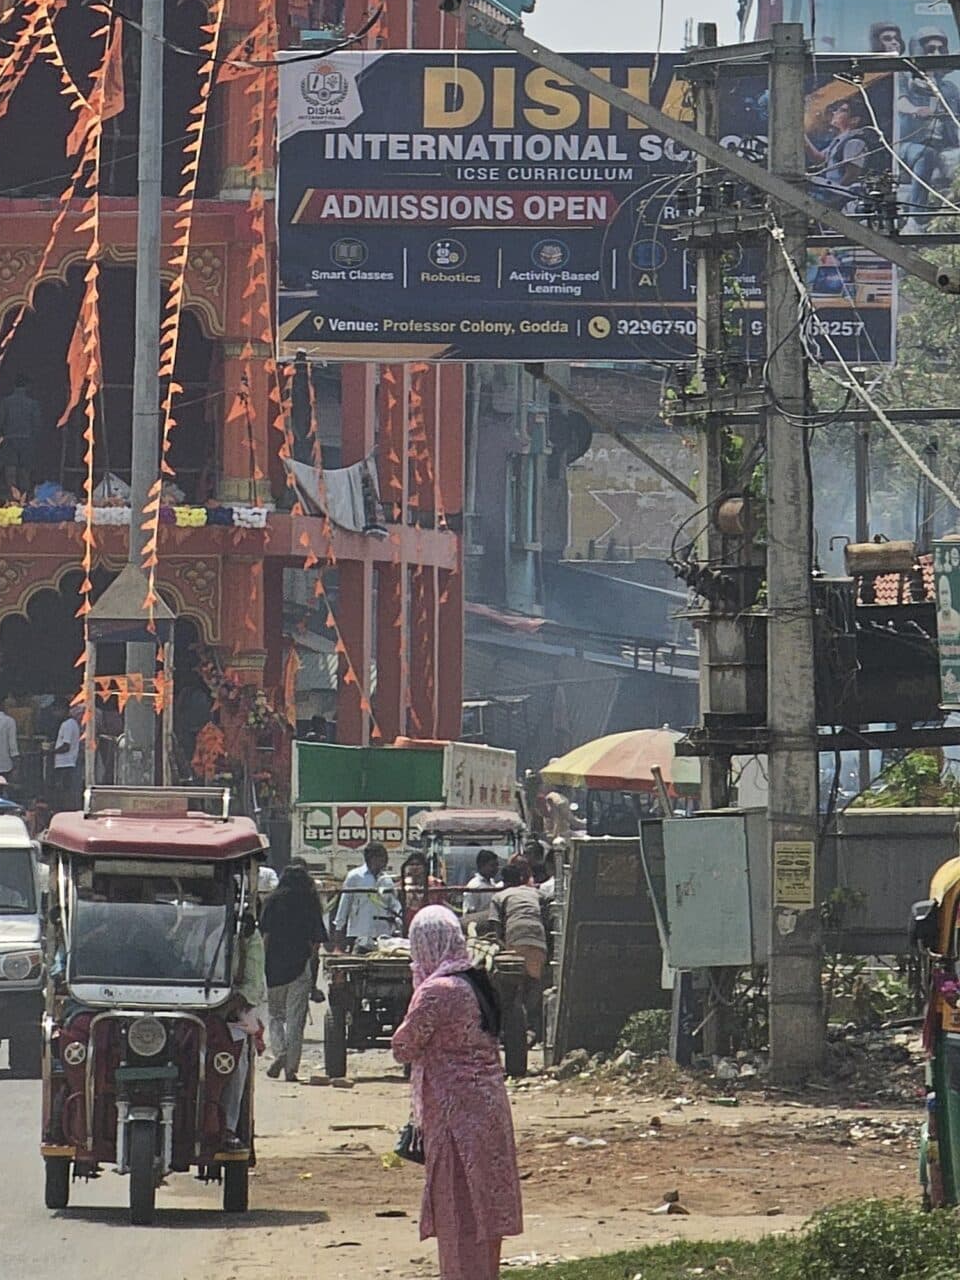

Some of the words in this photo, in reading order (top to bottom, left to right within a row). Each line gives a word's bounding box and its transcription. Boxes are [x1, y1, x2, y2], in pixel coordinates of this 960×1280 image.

[307, 106, 341, 115] DISHA
[325, 133, 627, 161] INTERNATIONAL
[457, 167, 500, 181] ICSE
[508, 168, 633, 181] CURRICULUM
[321, 194, 514, 220] ADMISSIONS
[524, 196, 607, 220] OPEN
[311, 270, 346, 280] Smart
[349, 270, 394, 280] Classes
[421, 272, 481, 283] Robotics
[509, 271, 600, 283] Activity-Based
[528, 284, 582, 296] Learning
[329, 318, 379, 331] Venue:
[383, 320, 455, 332] Professor
[460, 320, 515, 336] Colony,
[520, 320, 569, 333] Godda
[617, 320, 696, 335] 9296750
